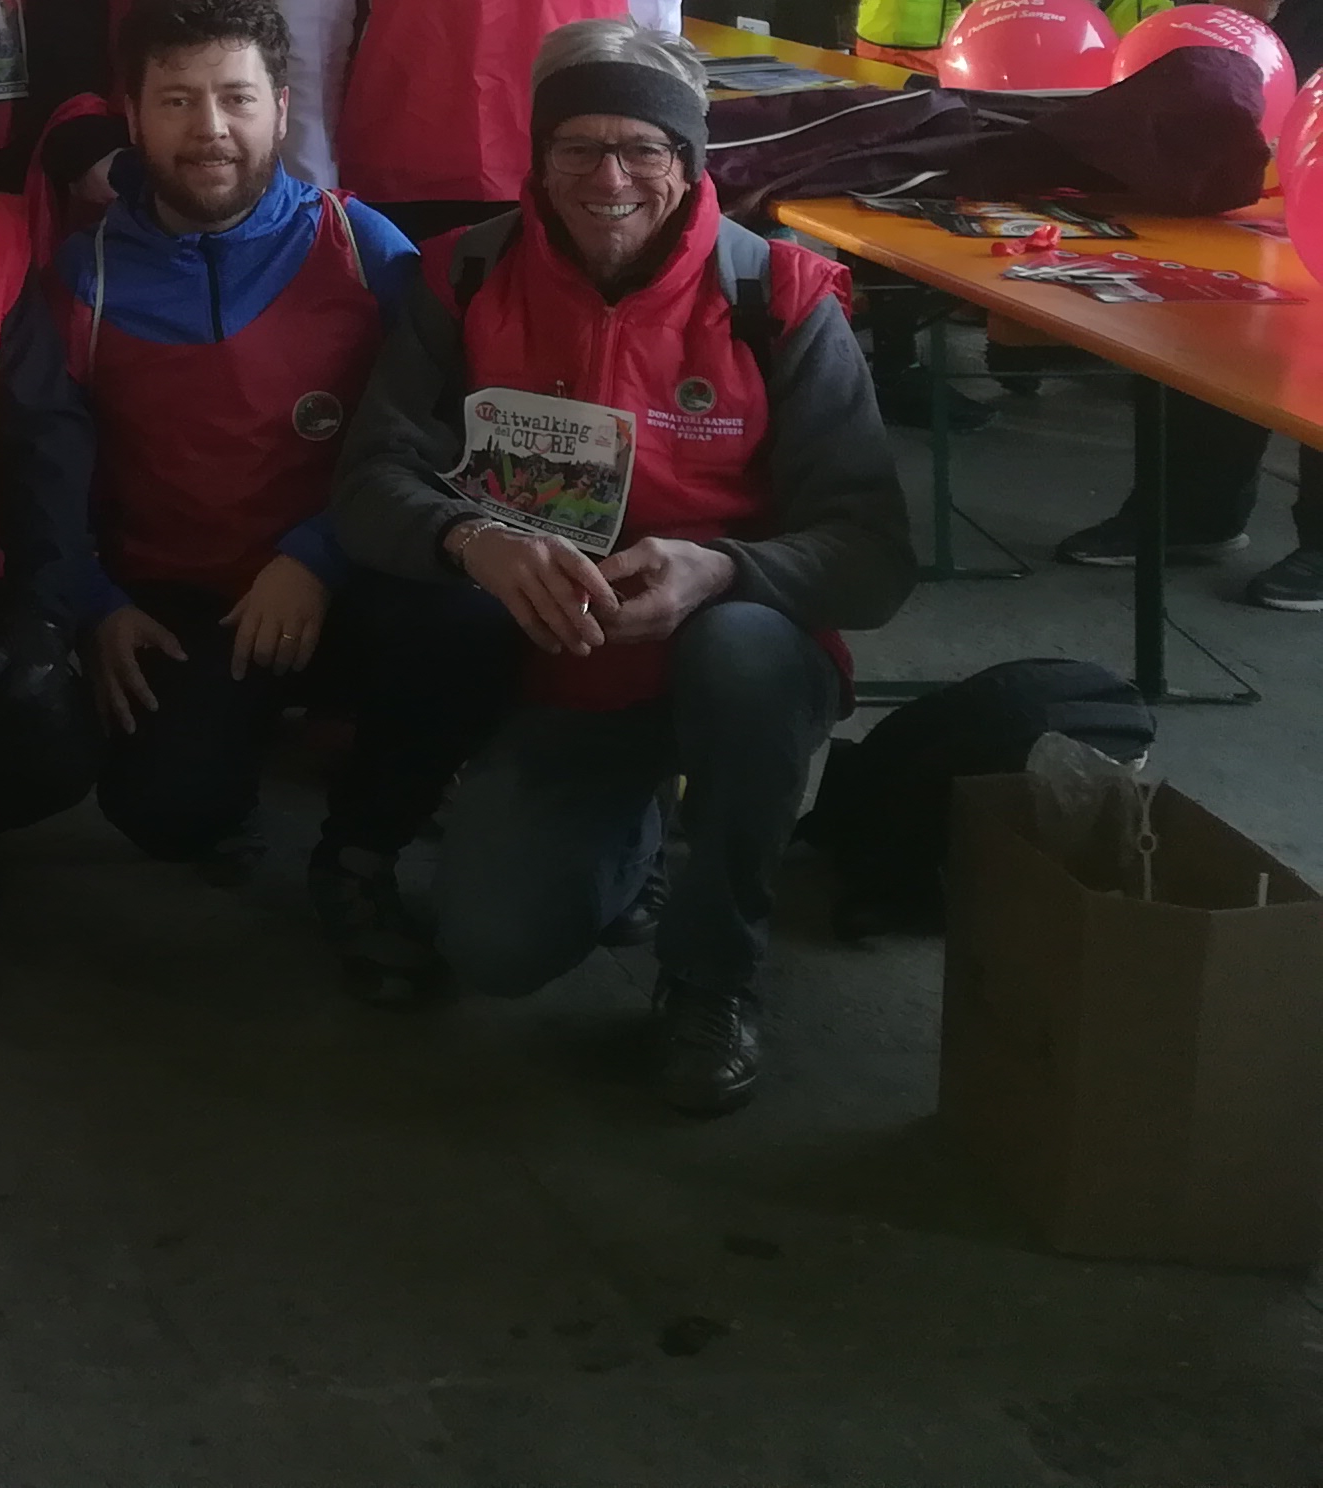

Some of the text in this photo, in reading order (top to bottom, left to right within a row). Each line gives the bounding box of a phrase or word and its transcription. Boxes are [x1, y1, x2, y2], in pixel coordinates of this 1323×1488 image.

[1019, 10, 1066, 22] Sangue
[492, 409, 592, 443] fitwalking
[648, 409, 744, 426] DONATORI SANGUE
[495, 427, 511, 437] del
[541, 521, 584, 539] GENNAIO
